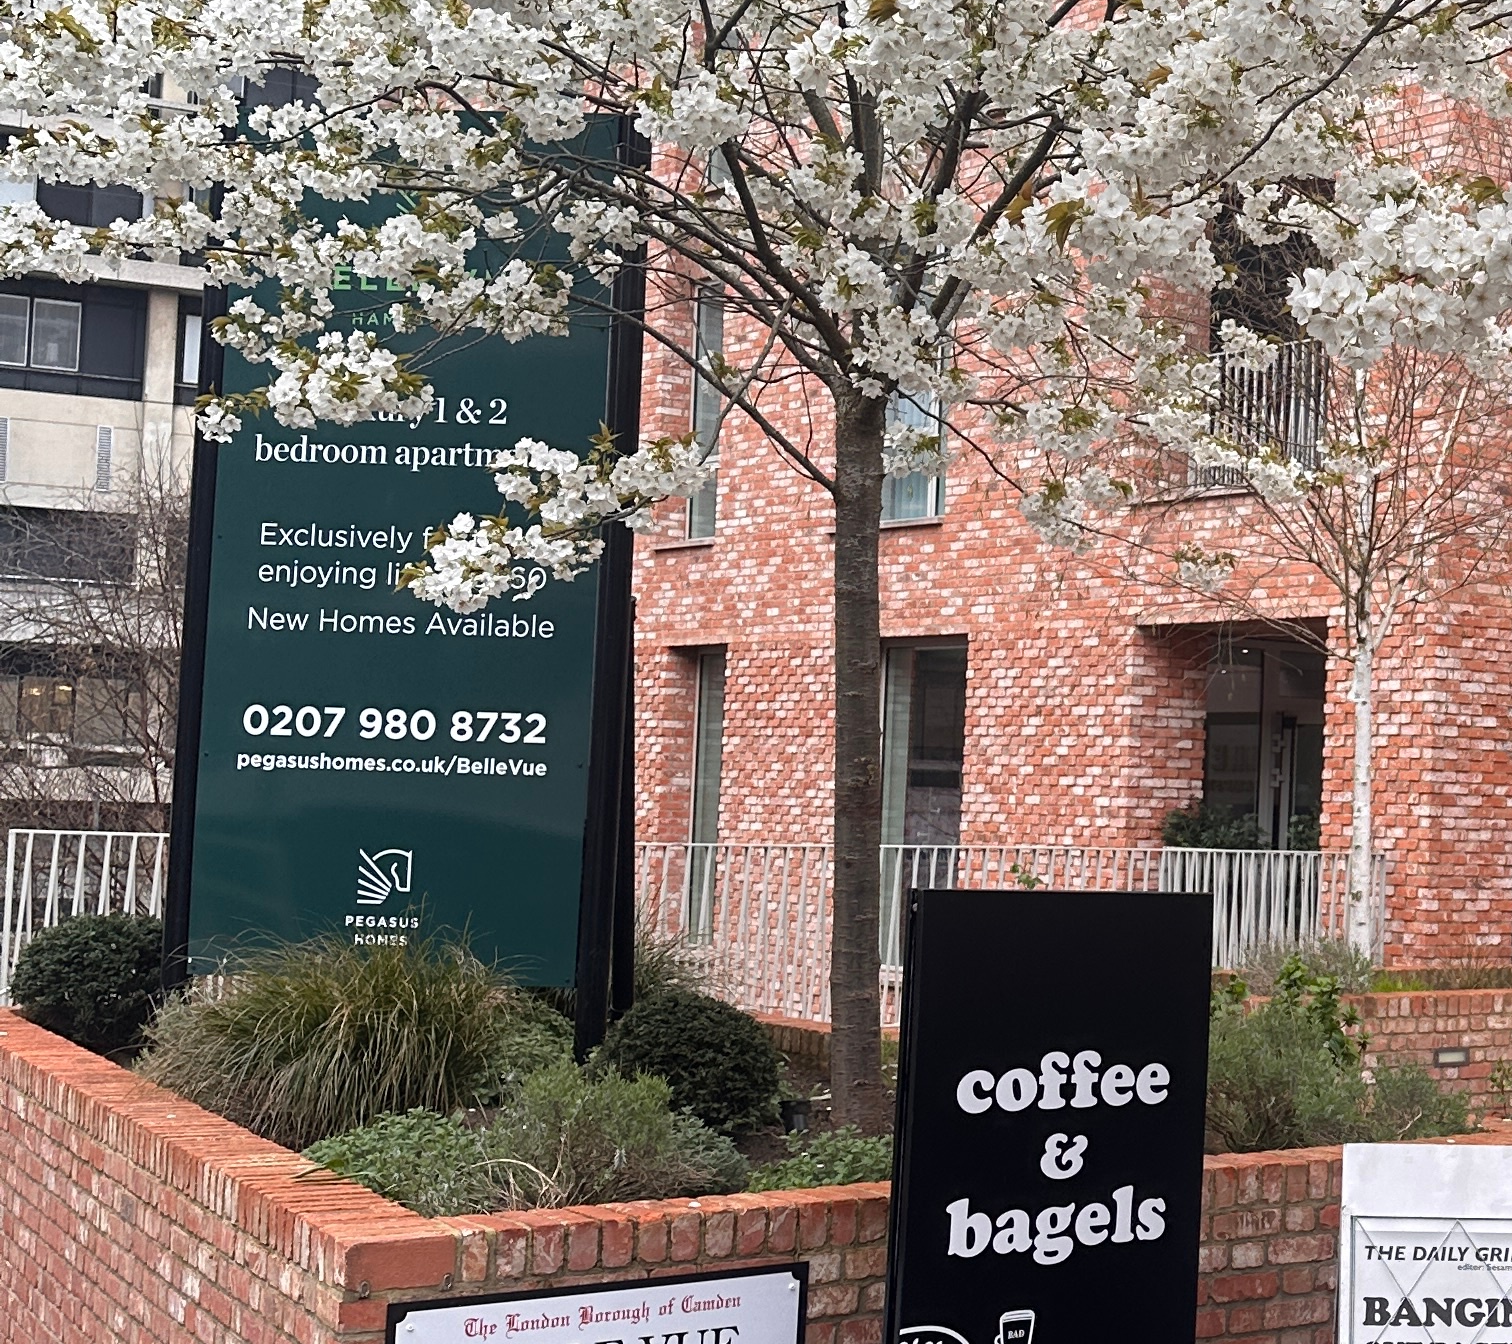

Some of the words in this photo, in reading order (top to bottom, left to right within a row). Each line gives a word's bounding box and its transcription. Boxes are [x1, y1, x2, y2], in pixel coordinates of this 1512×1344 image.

[434, 397, 449, 424] 1
[456, 397, 482, 425] &
[489, 398, 508, 425] 2
[254, 434, 388, 464] bedroom
[259, 522, 414, 554] Exclusively
[257, 562, 377, 590] enjoying
[247, 606, 310, 632] New
[318, 608, 416, 635] Homes
[424, 611, 555, 639] Available
[242, 703, 346, 738] 0207
[357, 707, 437, 741] 980
[449, 710, 548, 745] 8732
[236, 751, 548, 777] pegasushomes.co.uk/BelleVue
[344, 914, 419, 929] PEGASUS
[354, 933, 408, 947] HOMES
[956, 1049, 1171, 1114] coffee
[1040, 1133, 1089, 1180] &
[945, 1185, 1167, 1266] bagels
[1364, 1245, 1407, 1262] THE
[1412, 1246, 1470, 1263] DAILY
[464, 1317, 498, 1342] The
[505, 1312, 571, 1340] London
[578, 1302, 650, 1331] Borough
[658, 1297, 677, 1316] of
[681, 1293, 742, 1314] Camden
